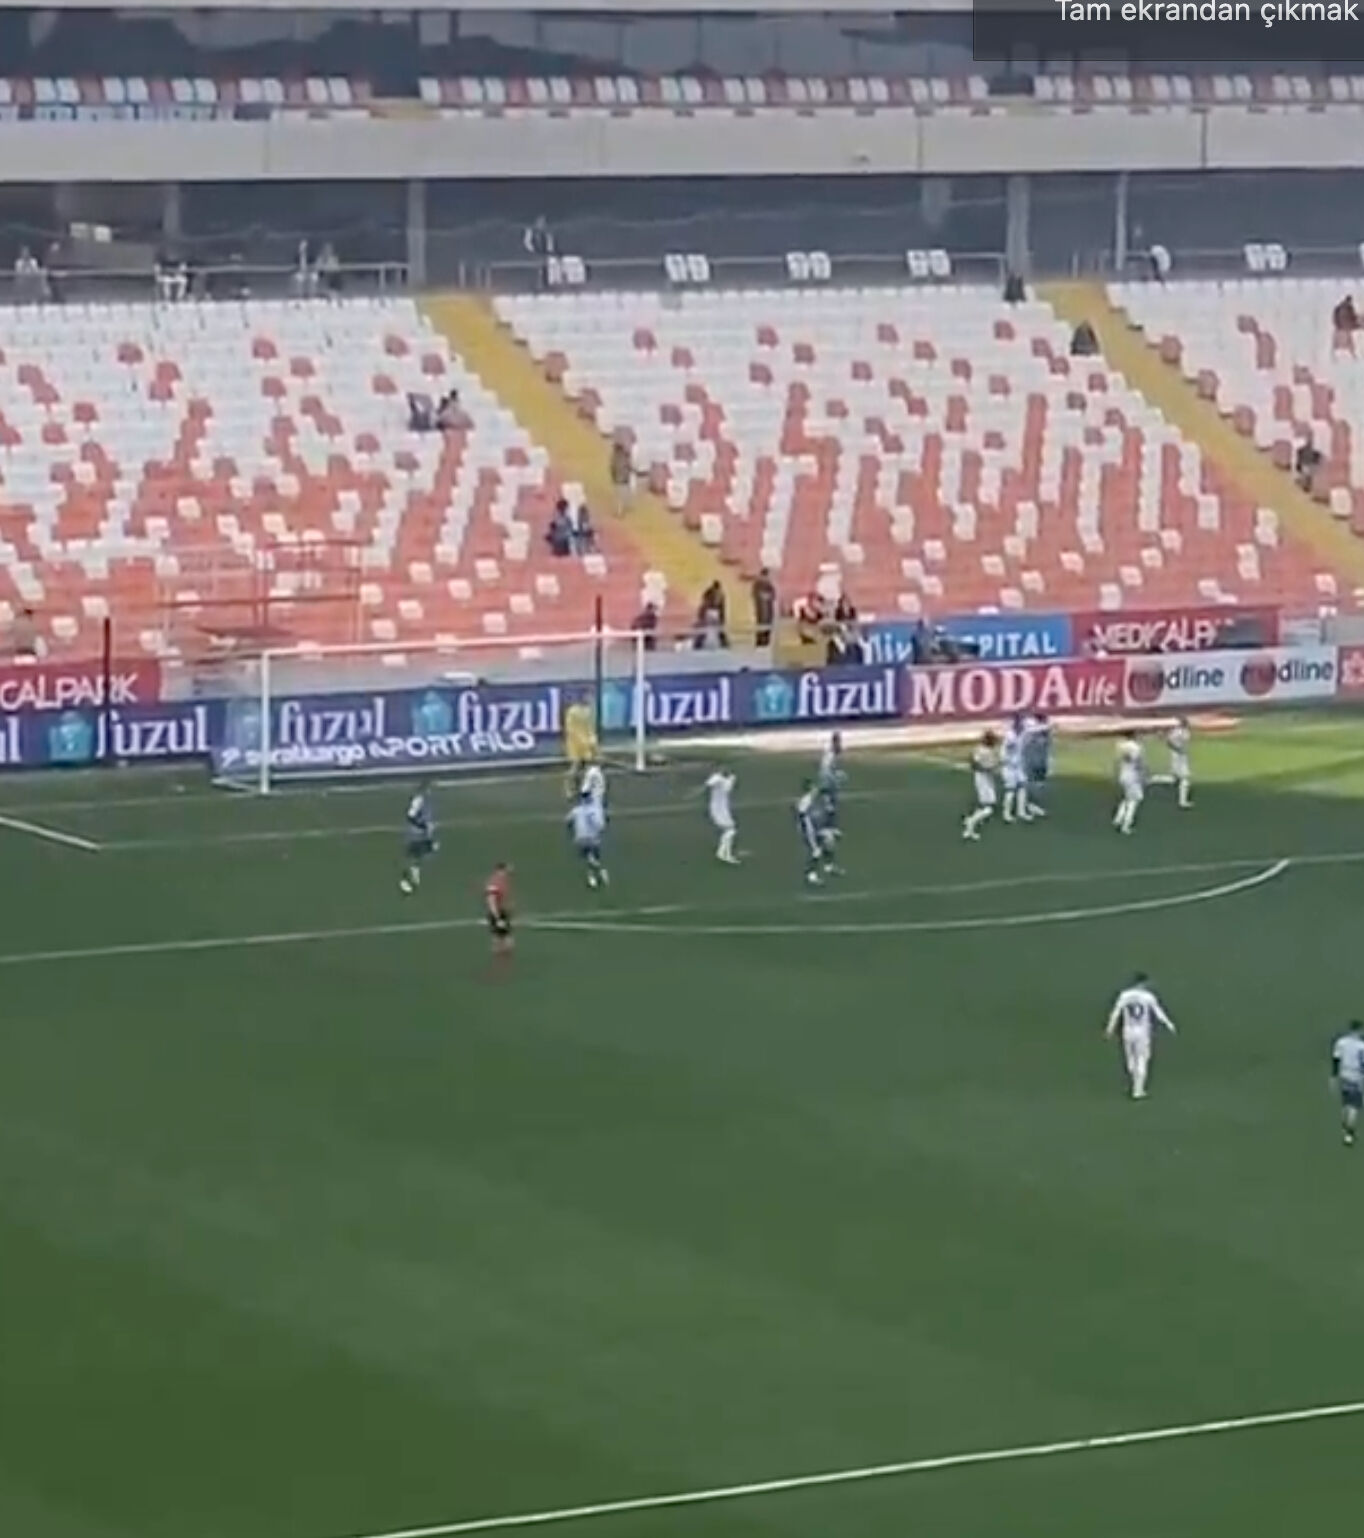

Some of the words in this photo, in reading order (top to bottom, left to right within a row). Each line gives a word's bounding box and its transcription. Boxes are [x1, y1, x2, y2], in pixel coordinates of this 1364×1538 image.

[458, 687, 562, 734] fuzul
[797, 668, 898, 717] fuzul
[910, 665, 1072, 716] MODA
[1076, 675, 1119, 707] Life
[280, 697, 385, 744] fuzul
